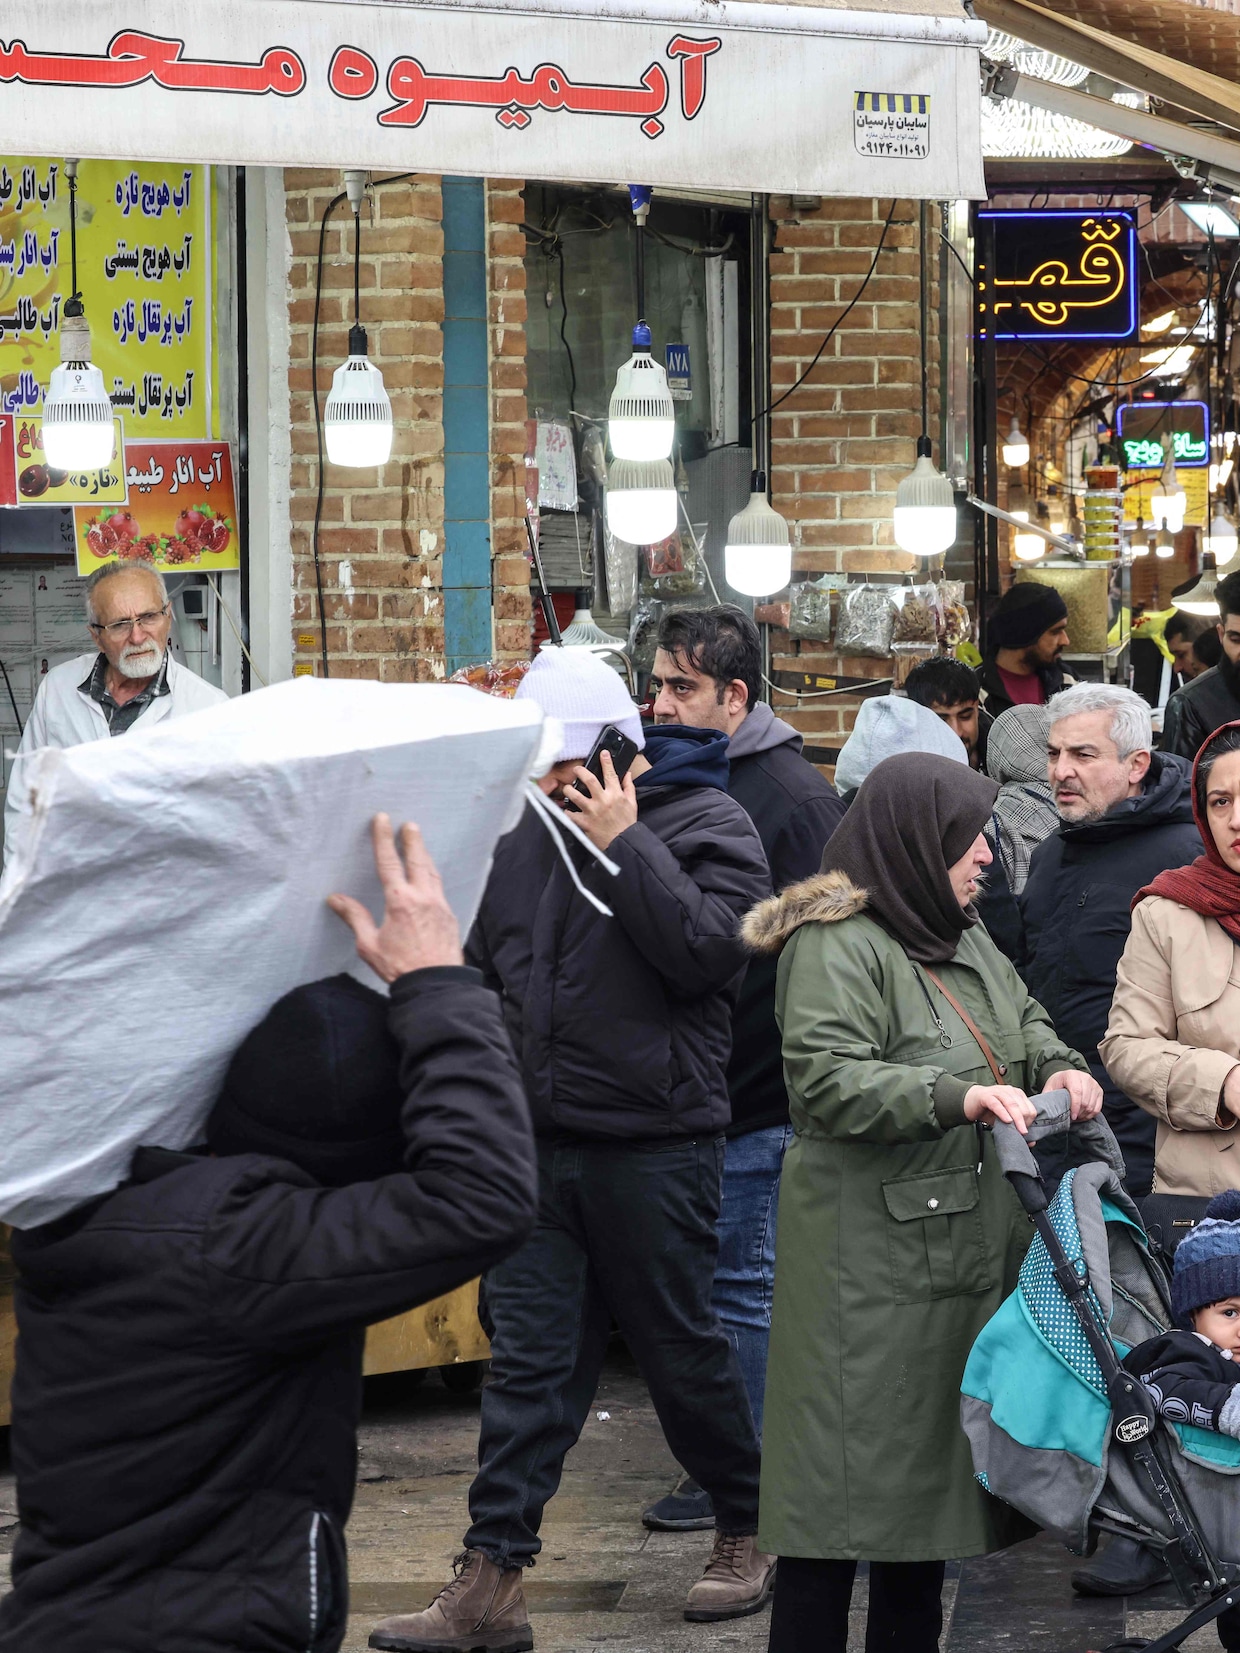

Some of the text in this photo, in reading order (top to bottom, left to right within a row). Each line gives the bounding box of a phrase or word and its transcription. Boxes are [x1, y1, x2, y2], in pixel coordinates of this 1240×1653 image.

[328, 33, 722, 139] آبمیوه
[856, 115, 927, 131] سایبان پارسیان
[16, 167, 35, 210] انار
[39, 166, 58, 210] آب
[116, 172, 192, 216] آب هویج تازه
[17, 232, 38, 275] انار
[40, 231, 59, 274] آب
[105, 236, 192, 279] آب هویج بستنی
[40, 296, 61, 339] آب
[113, 300, 192, 344] آب پرتقال تازه
[3, 373, 39, 413] طالبی
[109, 372, 193, 416] آب پرتقال بستن
[126, 452, 224, 494] آب انار طبیع
[1120, 1420, 1146, 1436] Happy World
